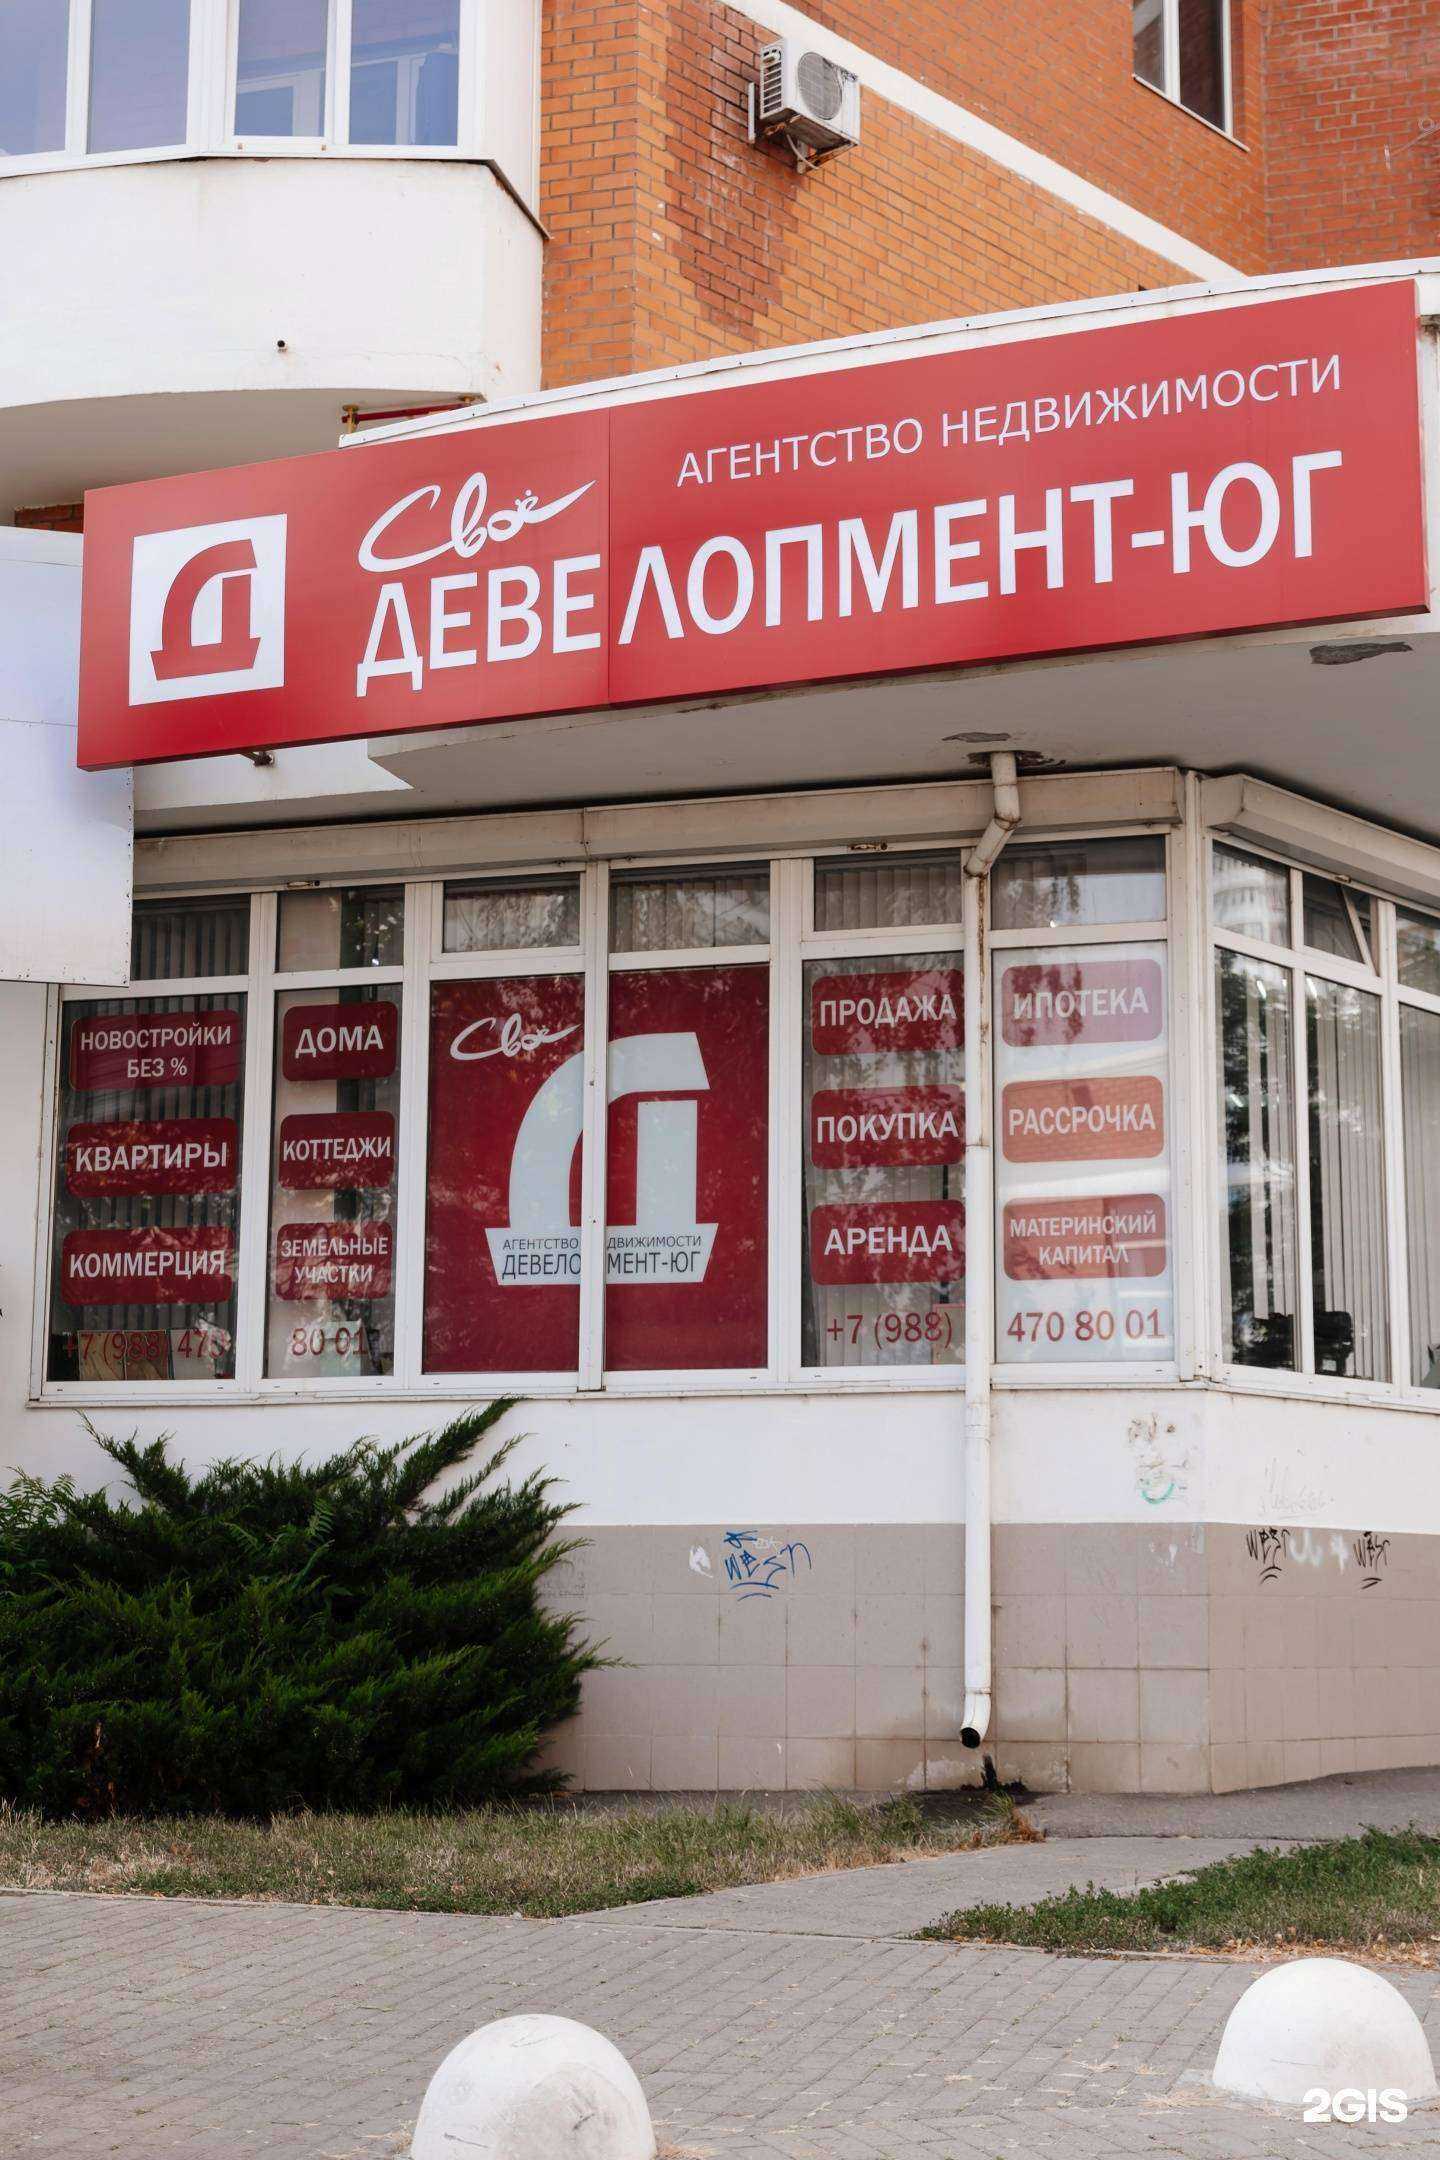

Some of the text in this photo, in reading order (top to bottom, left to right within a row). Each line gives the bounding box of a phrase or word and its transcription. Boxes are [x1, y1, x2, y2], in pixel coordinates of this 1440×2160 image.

[677, 354, 1342, 487] АГЕНТСТВО НЕДВИЖИМОСТИ
[356, 449, 1344, 698] ДЕВЕЛОПМЕНТ-ЮГ
[819, 993, 958, 1029] ПРОДАЖА
[1013, 986, 1150, 1021] ИПОТЕКА
[80, 1022, 232, 1052] НОВОСТРОЙКИ
[295, 1024, 384, 1060] ДОМА
[127, 1056, 188, 1079] БЕЗ %
[816, 1110, 959, 1143] ПОКУПКА
[1008, 1103, 1157, 1136] РАССРОЧКА
[75, 1142, 228, 1173] КВАРТИРЫ
[282, 1135, 392, 1163] КОТТЕДЖИ
[1010, 1209, 1157, 1238] МАТЕРИНСКИЙ
[281, 1237, 389, 1259] ЗЕМЕЛЬНЫЕ
[502, 1235, 702, 1251] АГЕНТСТВО ДВИЖИМОСТИ
[823, 1224, 953, 1258] АРЕНДА
[1039, 1243, 1129, 1266] КАПИТАЛ
[69, 1249, 226, 1281] КОММЕРЦИЯ
[294, 1264, 374, 1284] УЧАСТКИ
[502, 1250, 701, 1281] ДЕВЕЛОМЕНТ-ЮГ
[291, 1327, 325, 1356] 80
[335, 1326, 369, 1355] 01
[827, 1308, 1165, 1349] +7 (988) 470 80 01
